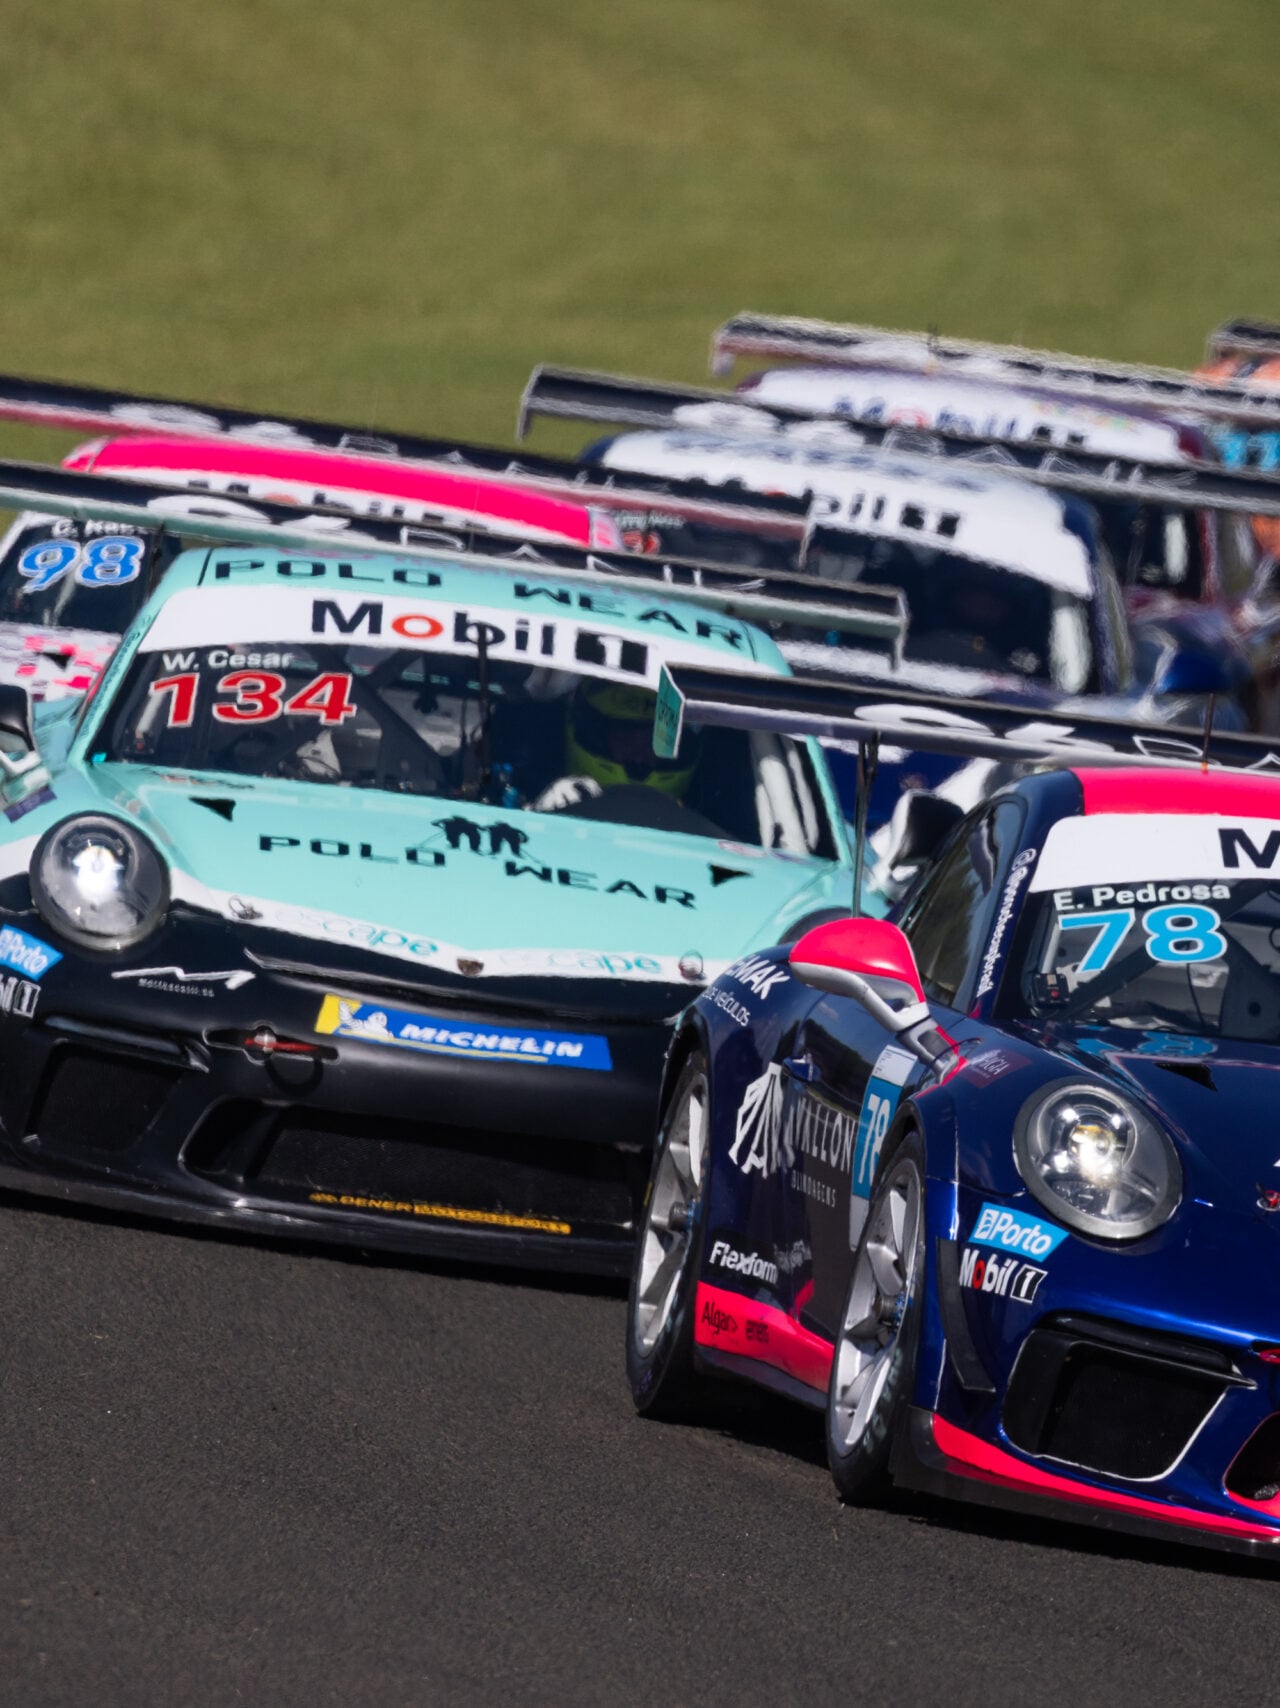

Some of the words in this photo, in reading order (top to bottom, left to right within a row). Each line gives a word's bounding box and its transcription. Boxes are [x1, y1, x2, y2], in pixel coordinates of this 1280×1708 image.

[18, 535, 146, 594] 98
[215, 559, 441, 586] POLO
[513, 583, 743, 650] WEAR
[312, 599, 554, 656] Mobil
[162, 651, 200, 671] W.
[208, 650, 295, 669] Cesar
[149, 669, 357, 728] 134
[259, 834, 446, 867] POLO
[505, 860, 696, 909] WEAR
[1053, 890, 1084, 911] E.
[1092, 883, 1231, 907] Pedrosa
[1057, 903, 1228, 974] 78
[400, 1023, 583, 1057] MICHELIN
[988, 1212, 1052, 1255] Porto
[959, 1248, 1019, 1296] Mobil
